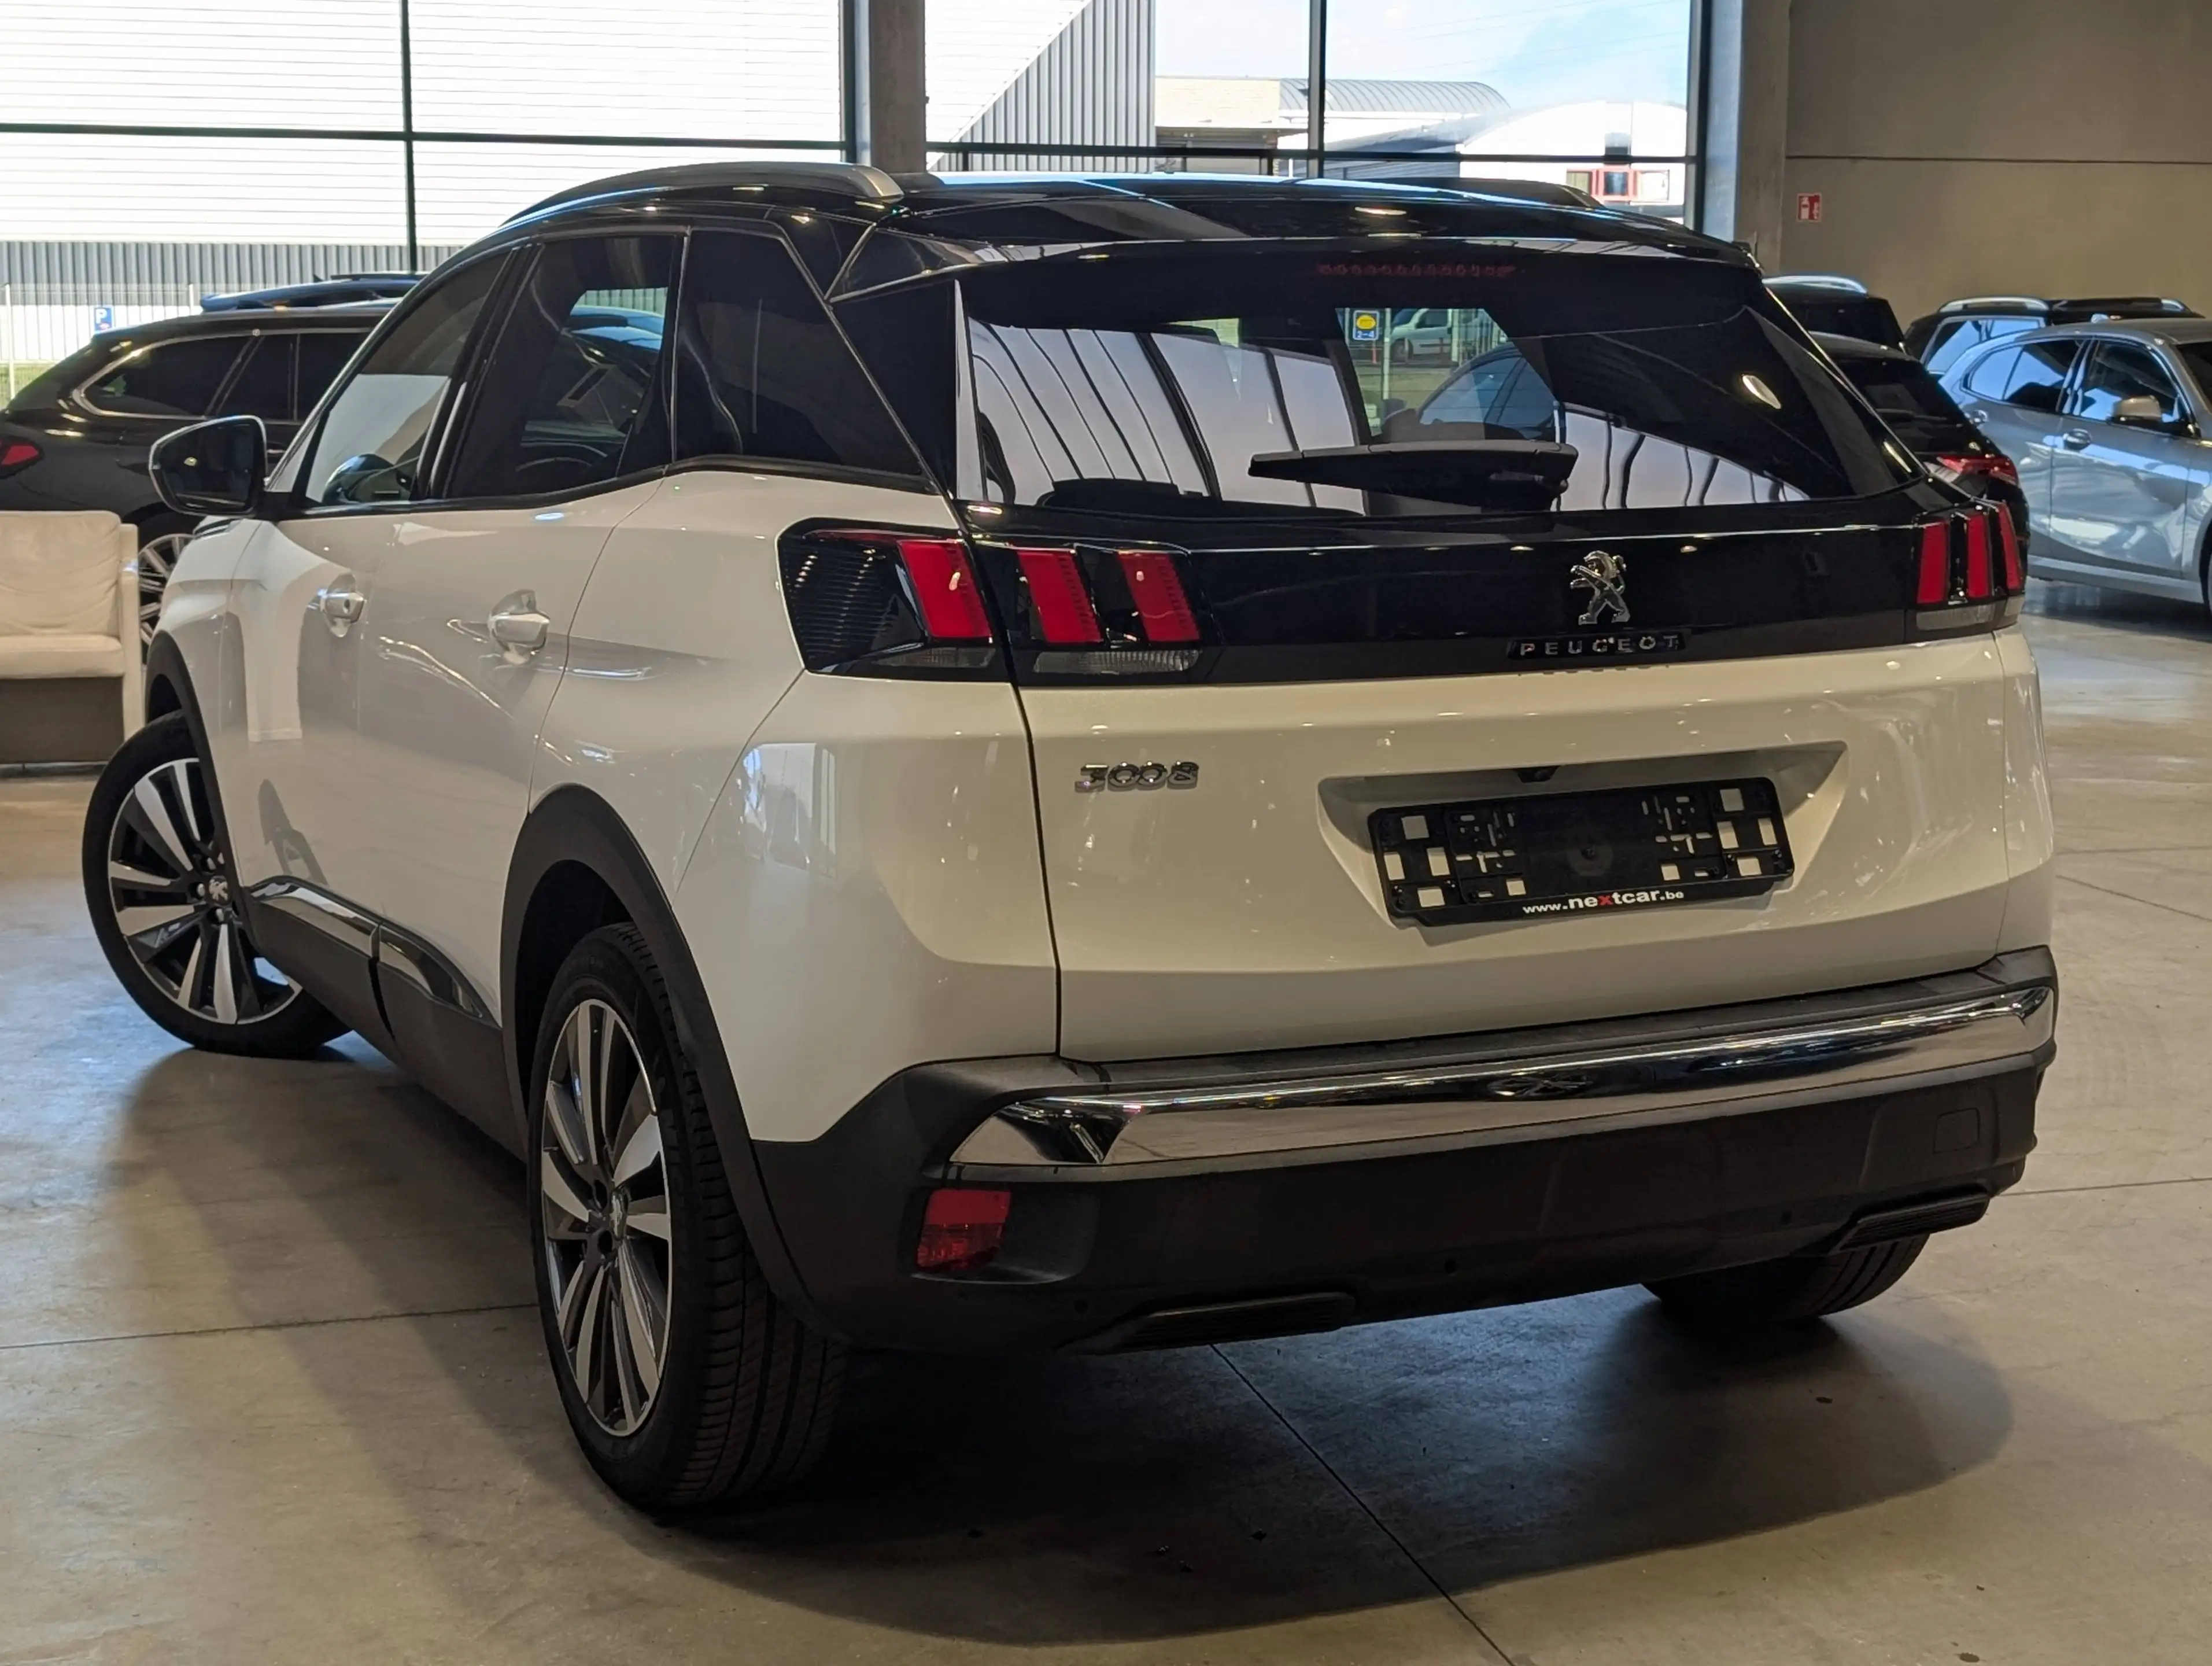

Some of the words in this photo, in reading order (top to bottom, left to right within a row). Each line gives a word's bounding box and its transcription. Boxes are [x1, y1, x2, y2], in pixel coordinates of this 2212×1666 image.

[96, 309, 107, 323] P
[1519, 635, 1679, 657] PEUGEOT
[1074, 761, 1199, 793] 3008
[1522, 889, 1685, 914] www.nextcar.be
